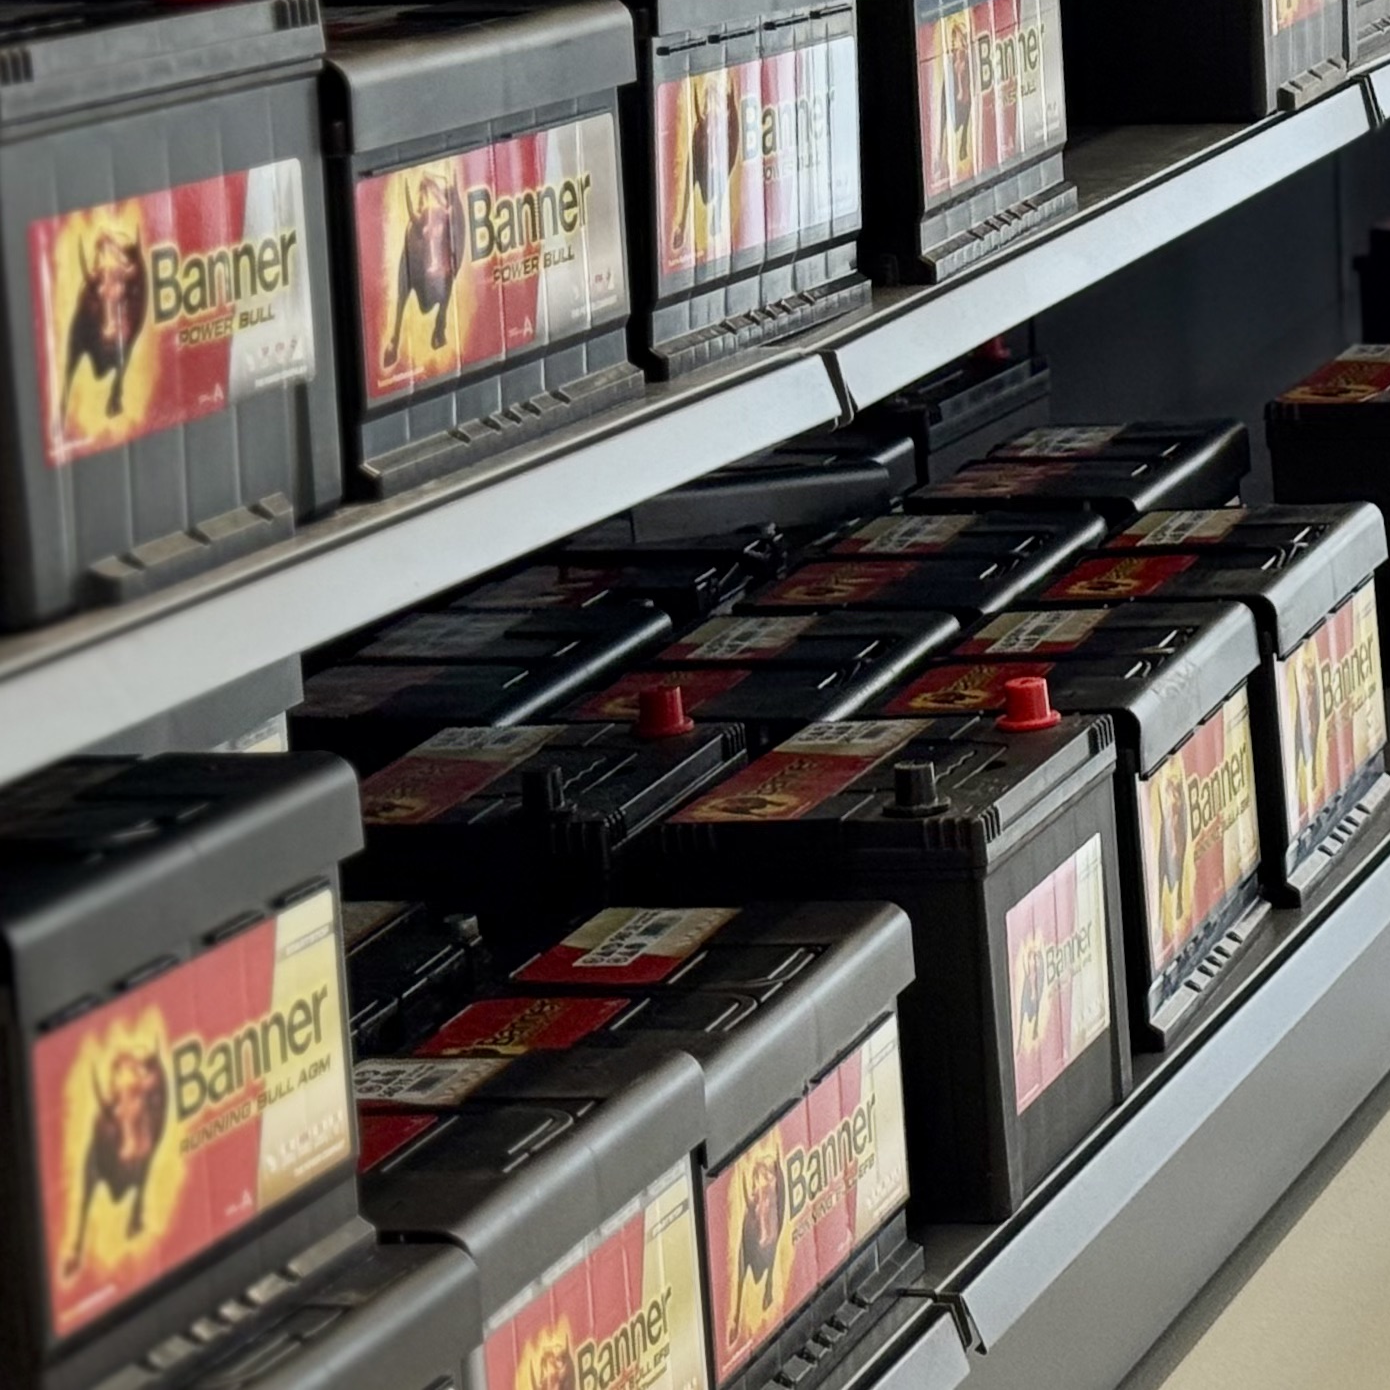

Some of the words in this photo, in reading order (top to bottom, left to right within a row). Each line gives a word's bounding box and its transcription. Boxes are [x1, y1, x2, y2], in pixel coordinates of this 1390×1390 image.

[466, 172, 591, 263] Banner
[493, 253, 539, 284] POWER
[543, 245, 575, 269] BULL
[151, 229, 297, 326] Banner
[178, 316, 233, 347] POWER
[238, 304, 276, 329] BULL
[1321, 632, 1374, 720] Banner
[1187, 742, 1247, 842] Banner
[1046, 919, 1092, 986] Banner
[171, 984, 328, 1123] Banner
[179, 1103, 252, 1155] RUNNING
[257, 1078, 295, 1111] BULL
[298, 1053, 332, 1087] AGM
[786, 1092, 876, 1220] Banner
[576, 1286, 672, 1390] Banner
